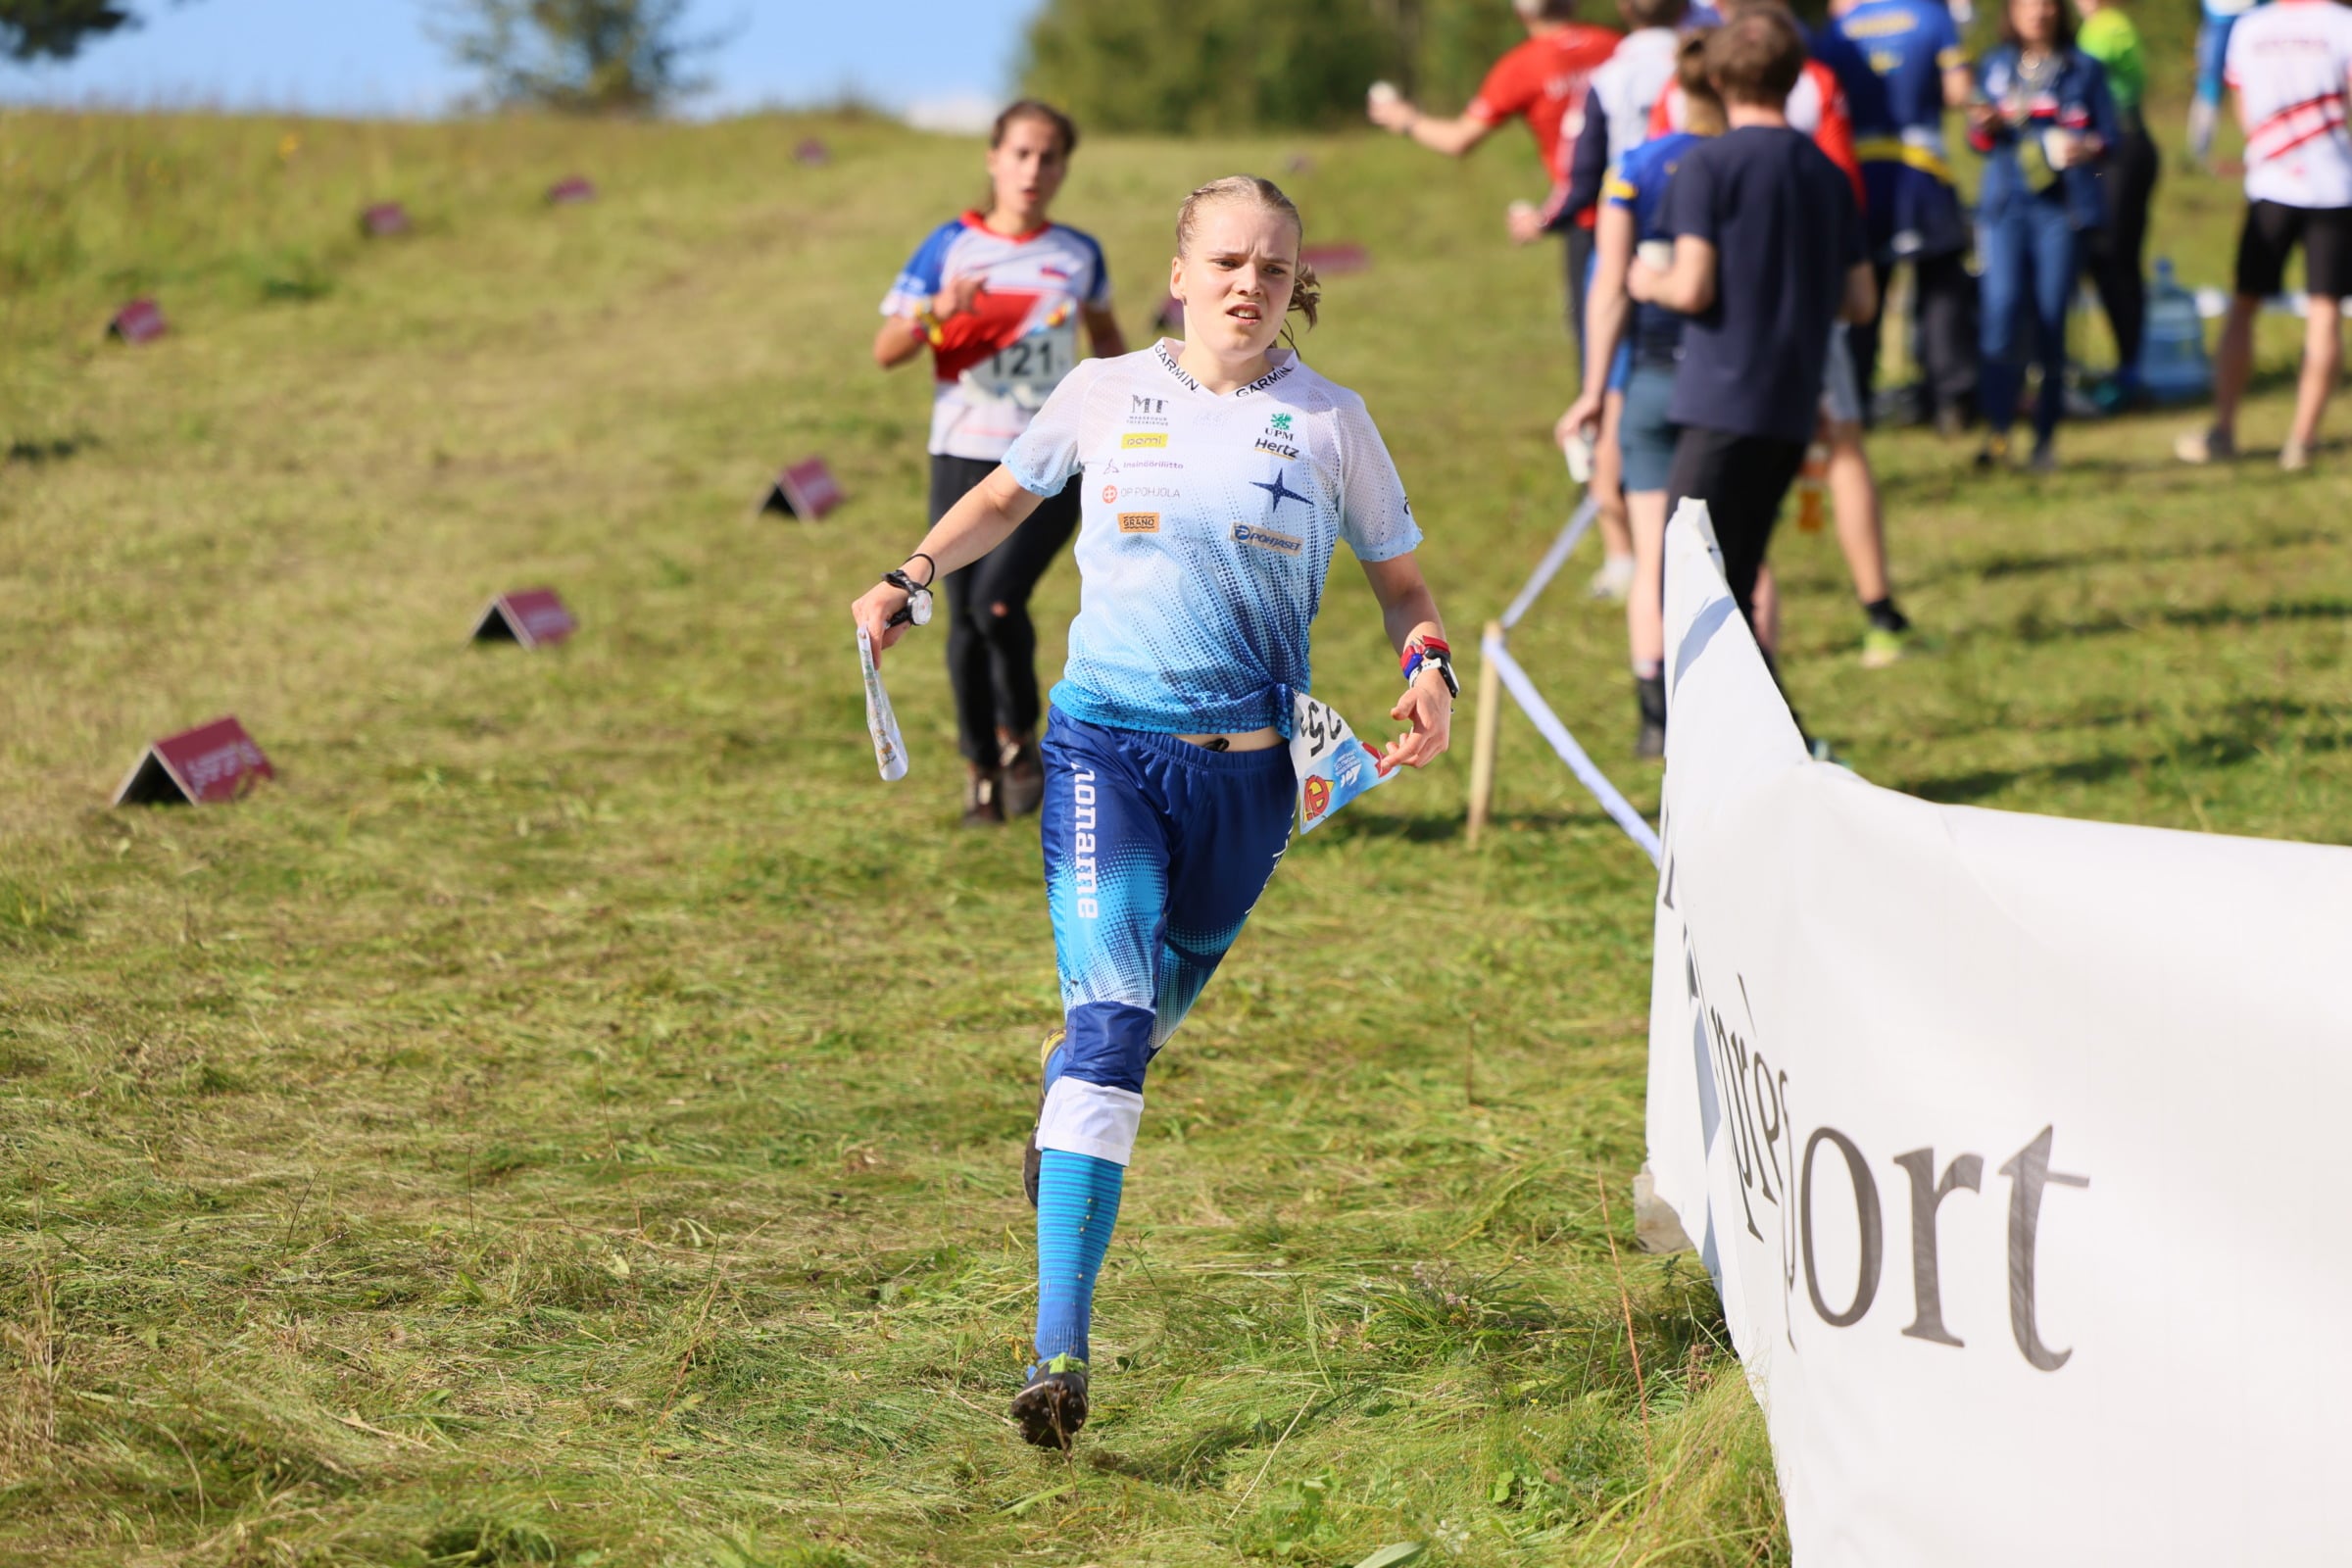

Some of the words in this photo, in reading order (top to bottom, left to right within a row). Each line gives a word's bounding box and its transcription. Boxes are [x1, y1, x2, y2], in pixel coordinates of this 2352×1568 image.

[1154, 344, 1200, 391] GARMIN
[1236, 366, 1293, 398] GARMIN
[1254, 438, 1299, 458] Hertz
[1264, 427, 1294, 441] UPM
[1071, 762, 1099, 919] noname
